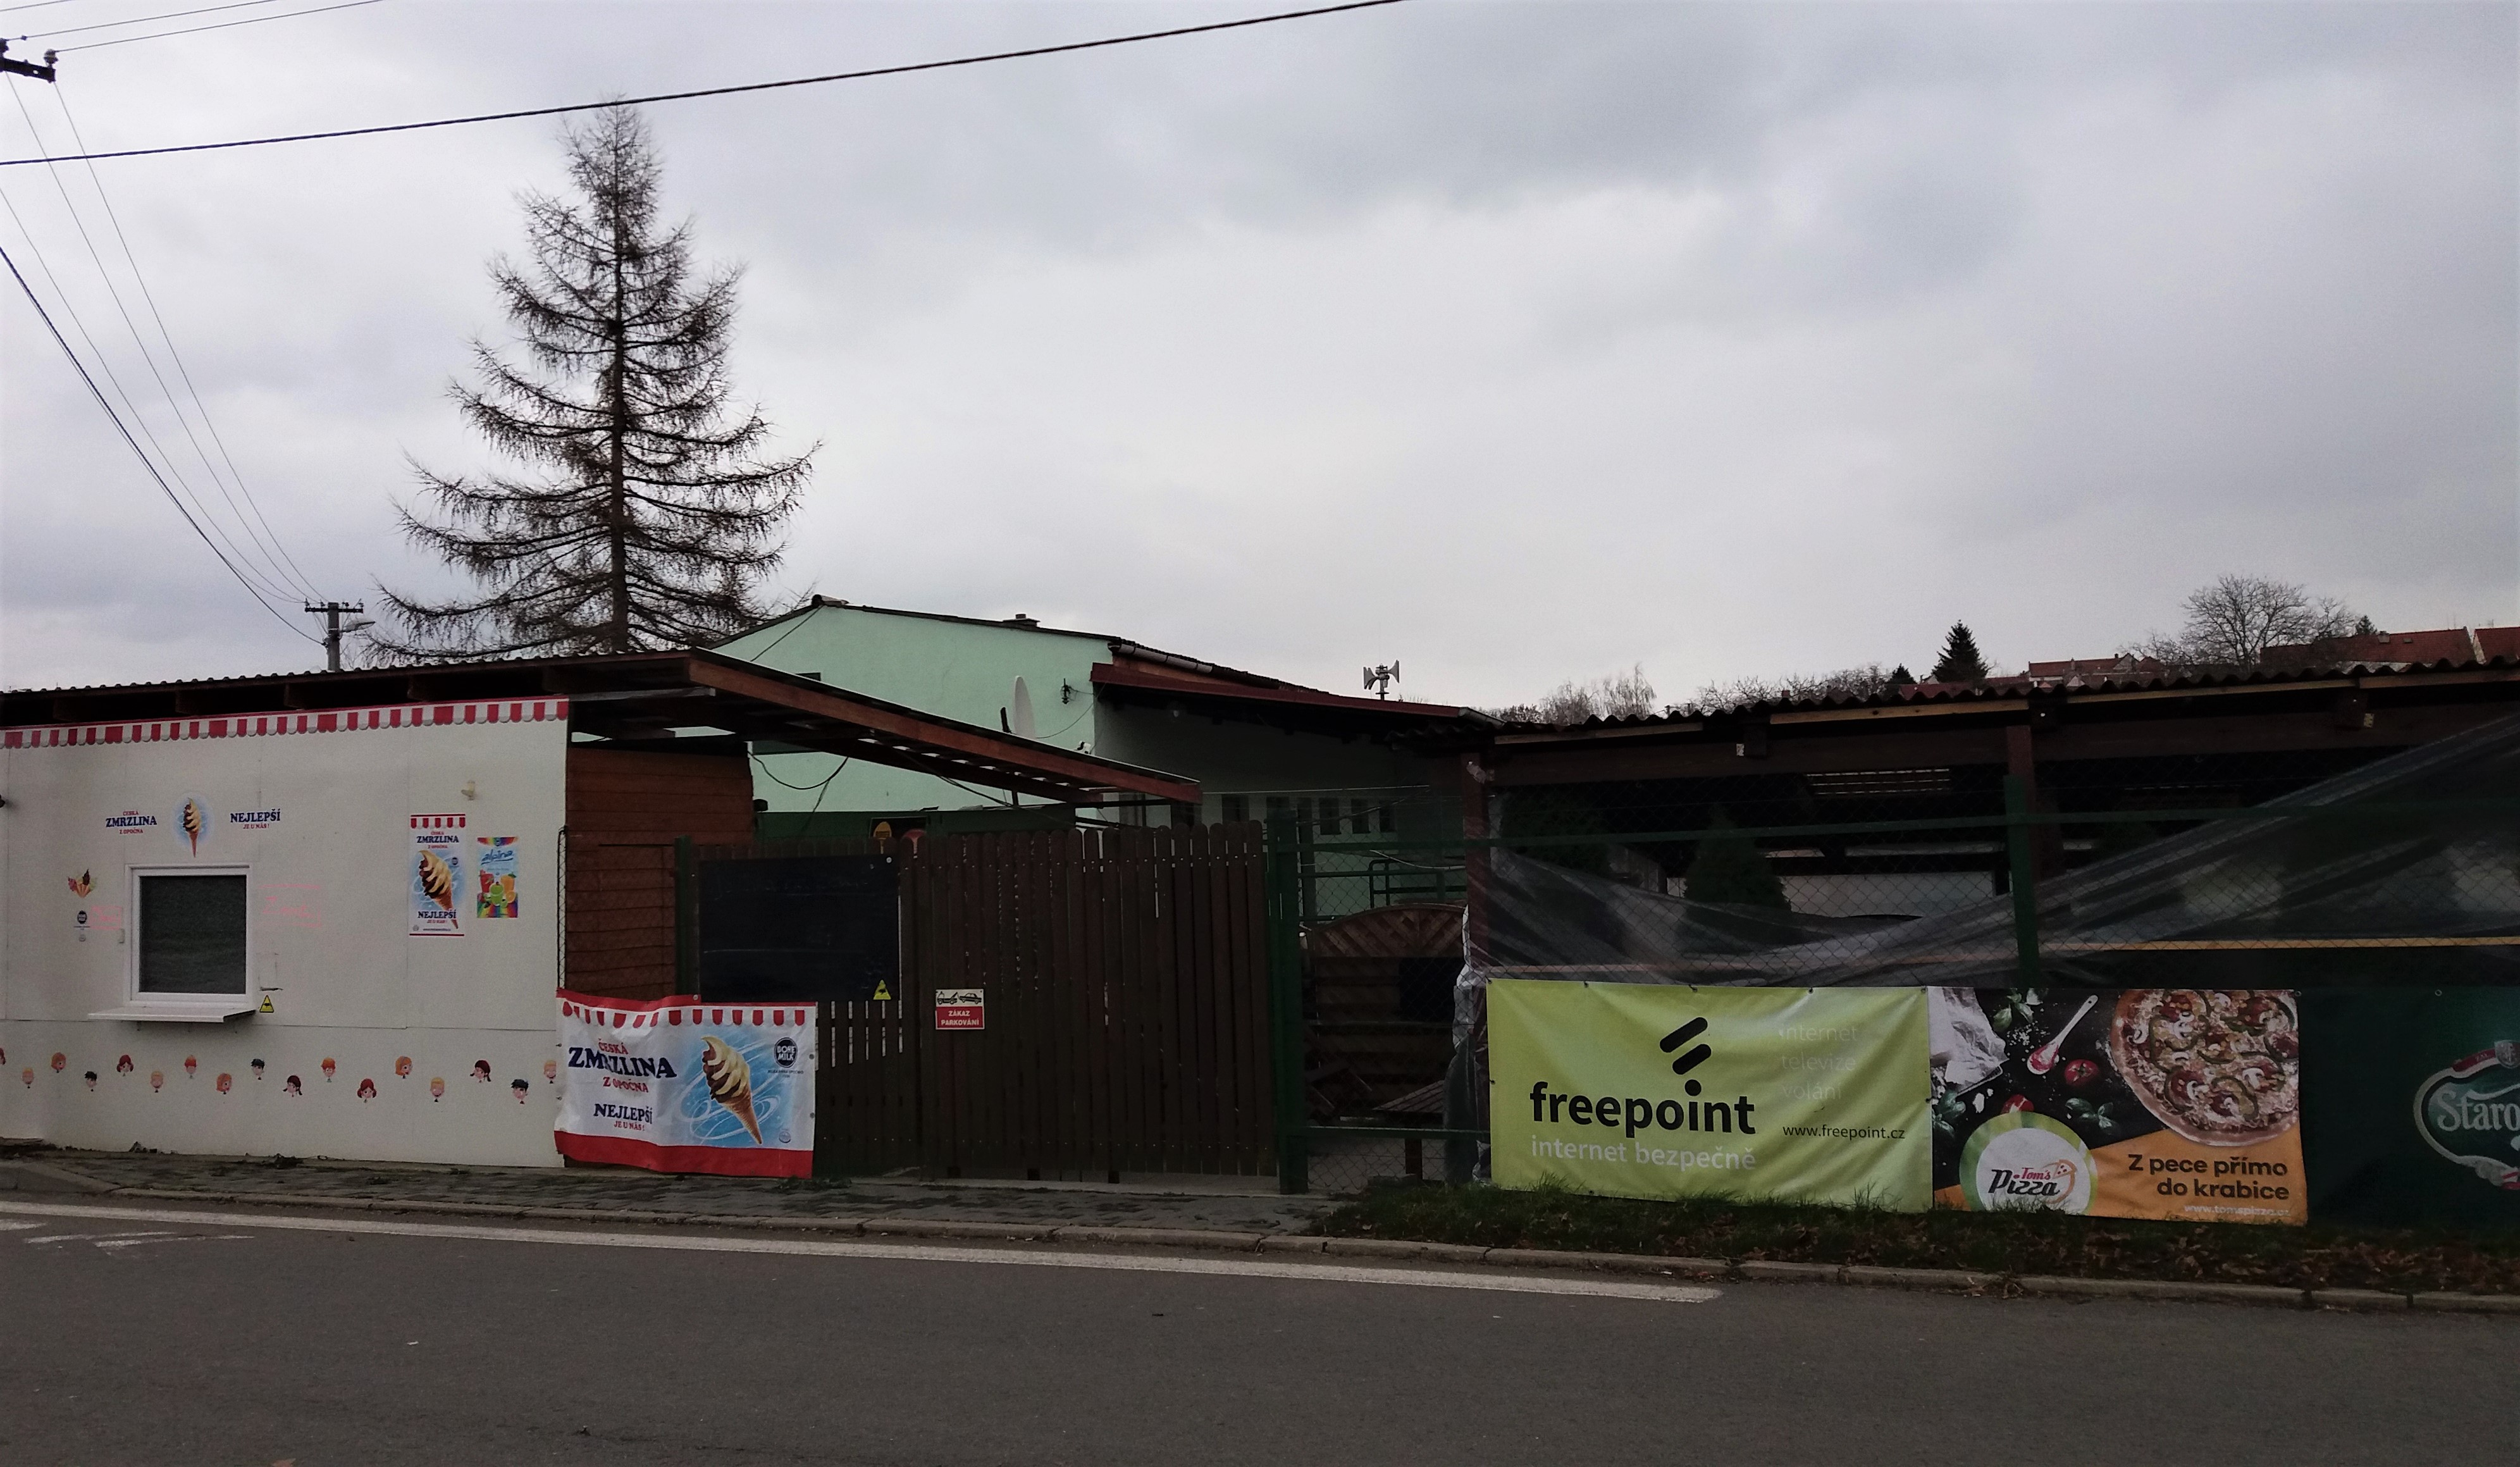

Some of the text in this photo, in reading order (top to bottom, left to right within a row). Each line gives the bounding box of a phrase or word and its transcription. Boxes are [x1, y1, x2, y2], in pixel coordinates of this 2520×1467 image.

[106, 815, 157, 827] ZMRZLINA
[230, 808, 280, 822] NEJLEPŠÍ
[416, 835, 459, 843] ZMRZLINA
[417, 910, 457, 919] NEJLEPŠÍ
[598, 1038, 628, 1055] ČESKÁ
[568, 1047, 677, 1079] ZMRZLINA
[777, 1053, 794, 1061] MILK
[1781, 1052, 1856, 1071] televize
[603, 1077, 649, 1093] Z OPOČNA
[593, 1103, 652, 1124] NEJLEPŠÍ
[1529, 1079, 1756, 1139] freepoint
[1782, 1124, 1905, 1141] www.freepoint.cz
[1532, 1135, 1756, 1172] internet bezpečně
[2022, 1167, 2051, 1180] Tom's
[2128, 1154, 2288, 1177] Z pece přímo
[1988, 1169, 2060, 1196] Pizza
[2157, 1177, 2289, 1199] do krabice
